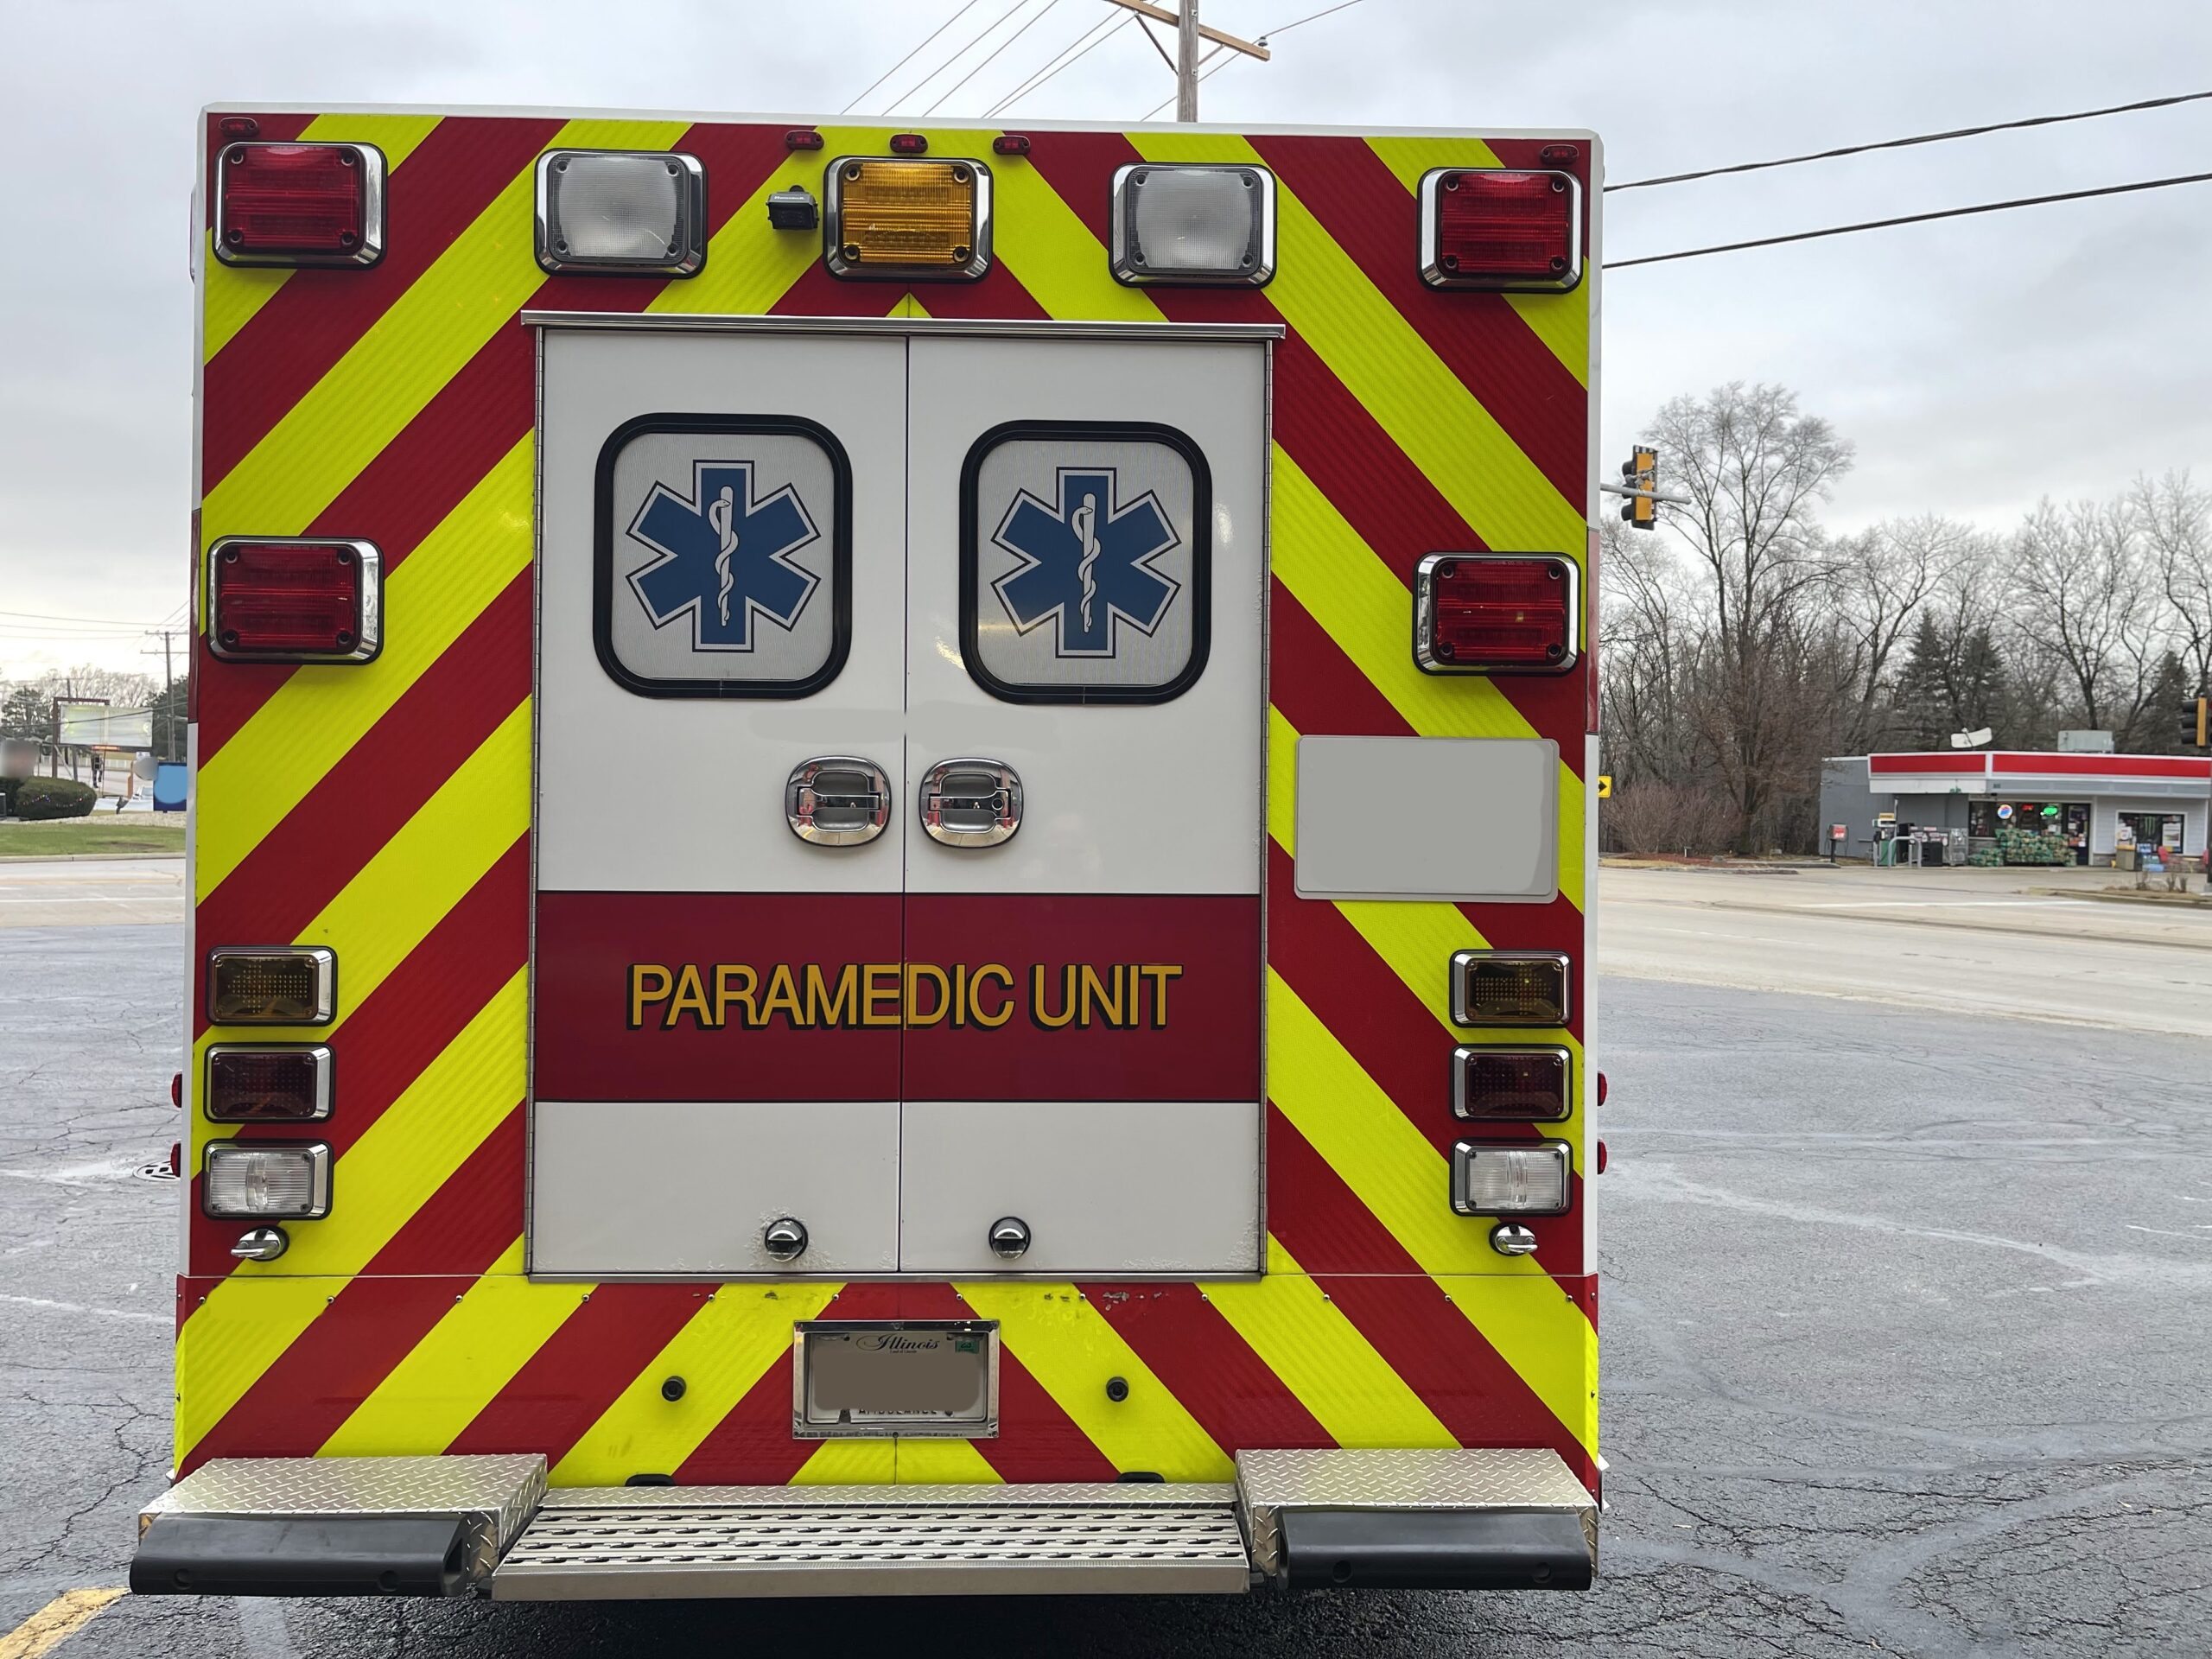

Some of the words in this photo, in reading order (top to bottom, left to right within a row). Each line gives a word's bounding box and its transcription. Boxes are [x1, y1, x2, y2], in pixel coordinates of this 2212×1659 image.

[628, 963, 1015, 1030] PARAMEDIC
[1030, 963, 1184, 1030] UNIT
[856, 1333, 939, 1351] Illinois
